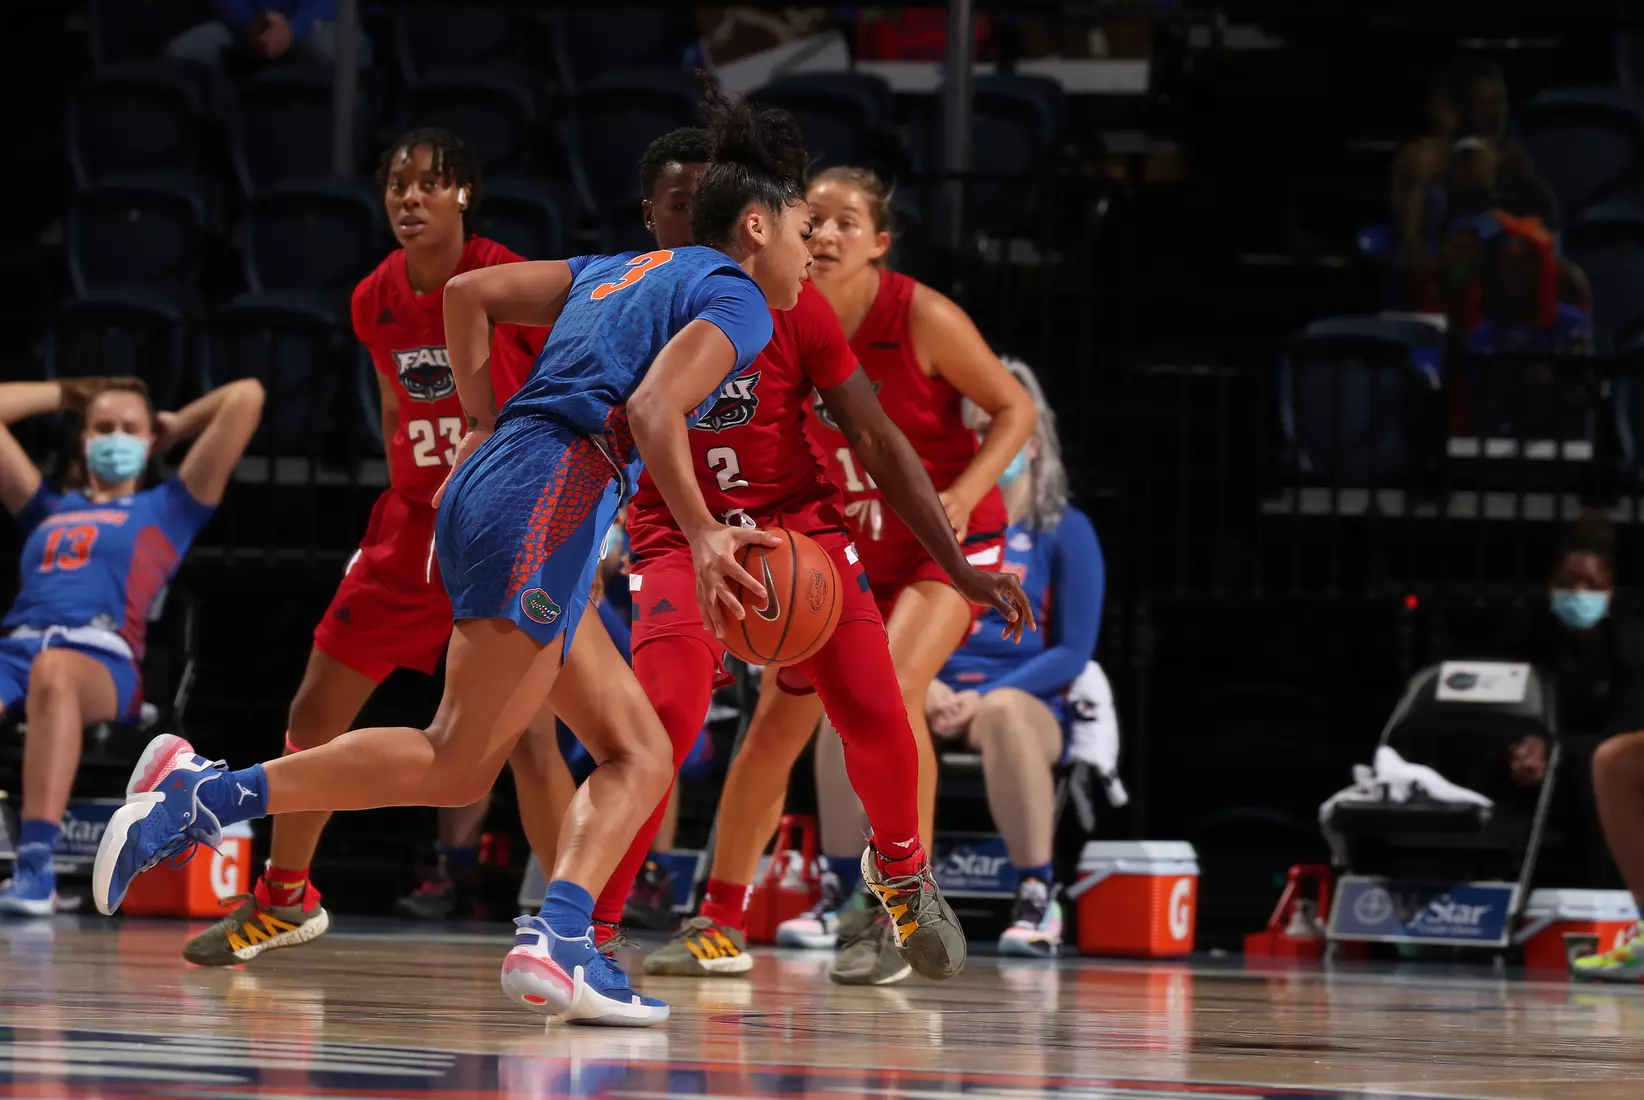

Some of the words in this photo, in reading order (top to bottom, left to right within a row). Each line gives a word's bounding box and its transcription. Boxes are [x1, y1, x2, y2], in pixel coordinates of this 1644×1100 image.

[591, 249, 674, 300] 3
[408, 417, 462, 467] 23
[707, 446, 749, 492] 2
[835, 447, 878, 492] 1
[39, 524, 99, 573] 13
[210, 840, 239, 899] G
[1167, 877, 1192, 940] G
